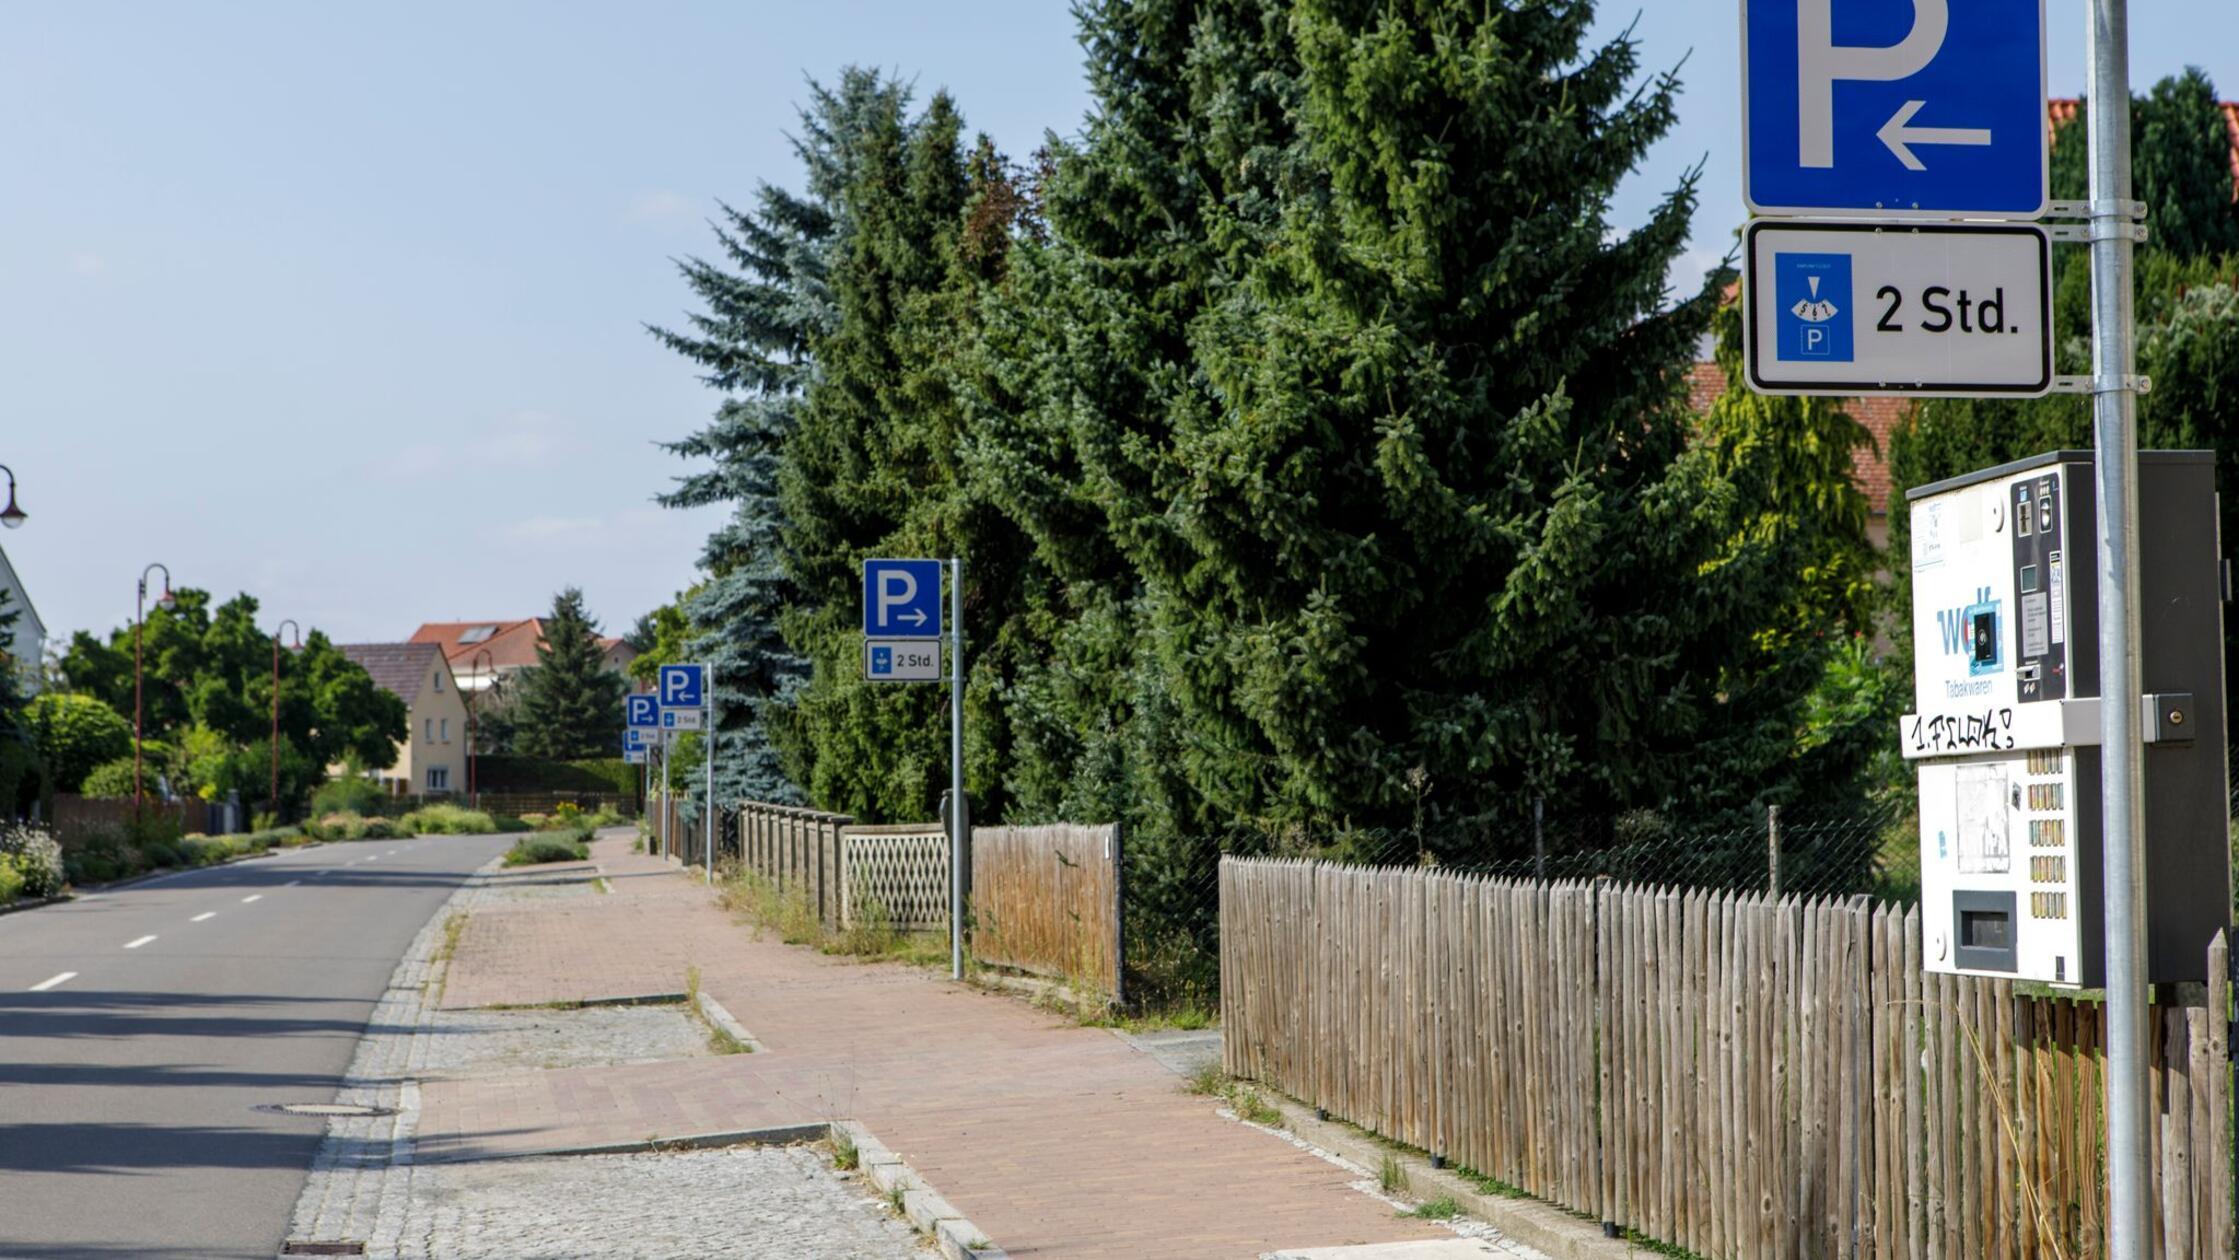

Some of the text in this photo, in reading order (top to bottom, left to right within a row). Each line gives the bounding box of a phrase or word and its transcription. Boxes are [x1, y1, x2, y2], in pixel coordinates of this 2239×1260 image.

[1797, 0, 1949, 168] P
[1876, 286, 2019, 335] 2 Std.
[1807, 328, 1823, 351] P
[877, 569, 918, 627] P
[897, 654, 934, 668] 2 Std.
[667, 670, 689, 702] P
[1945, 680, 1993, 699] Tabakwaren
[633, 699, 650, 723] P
